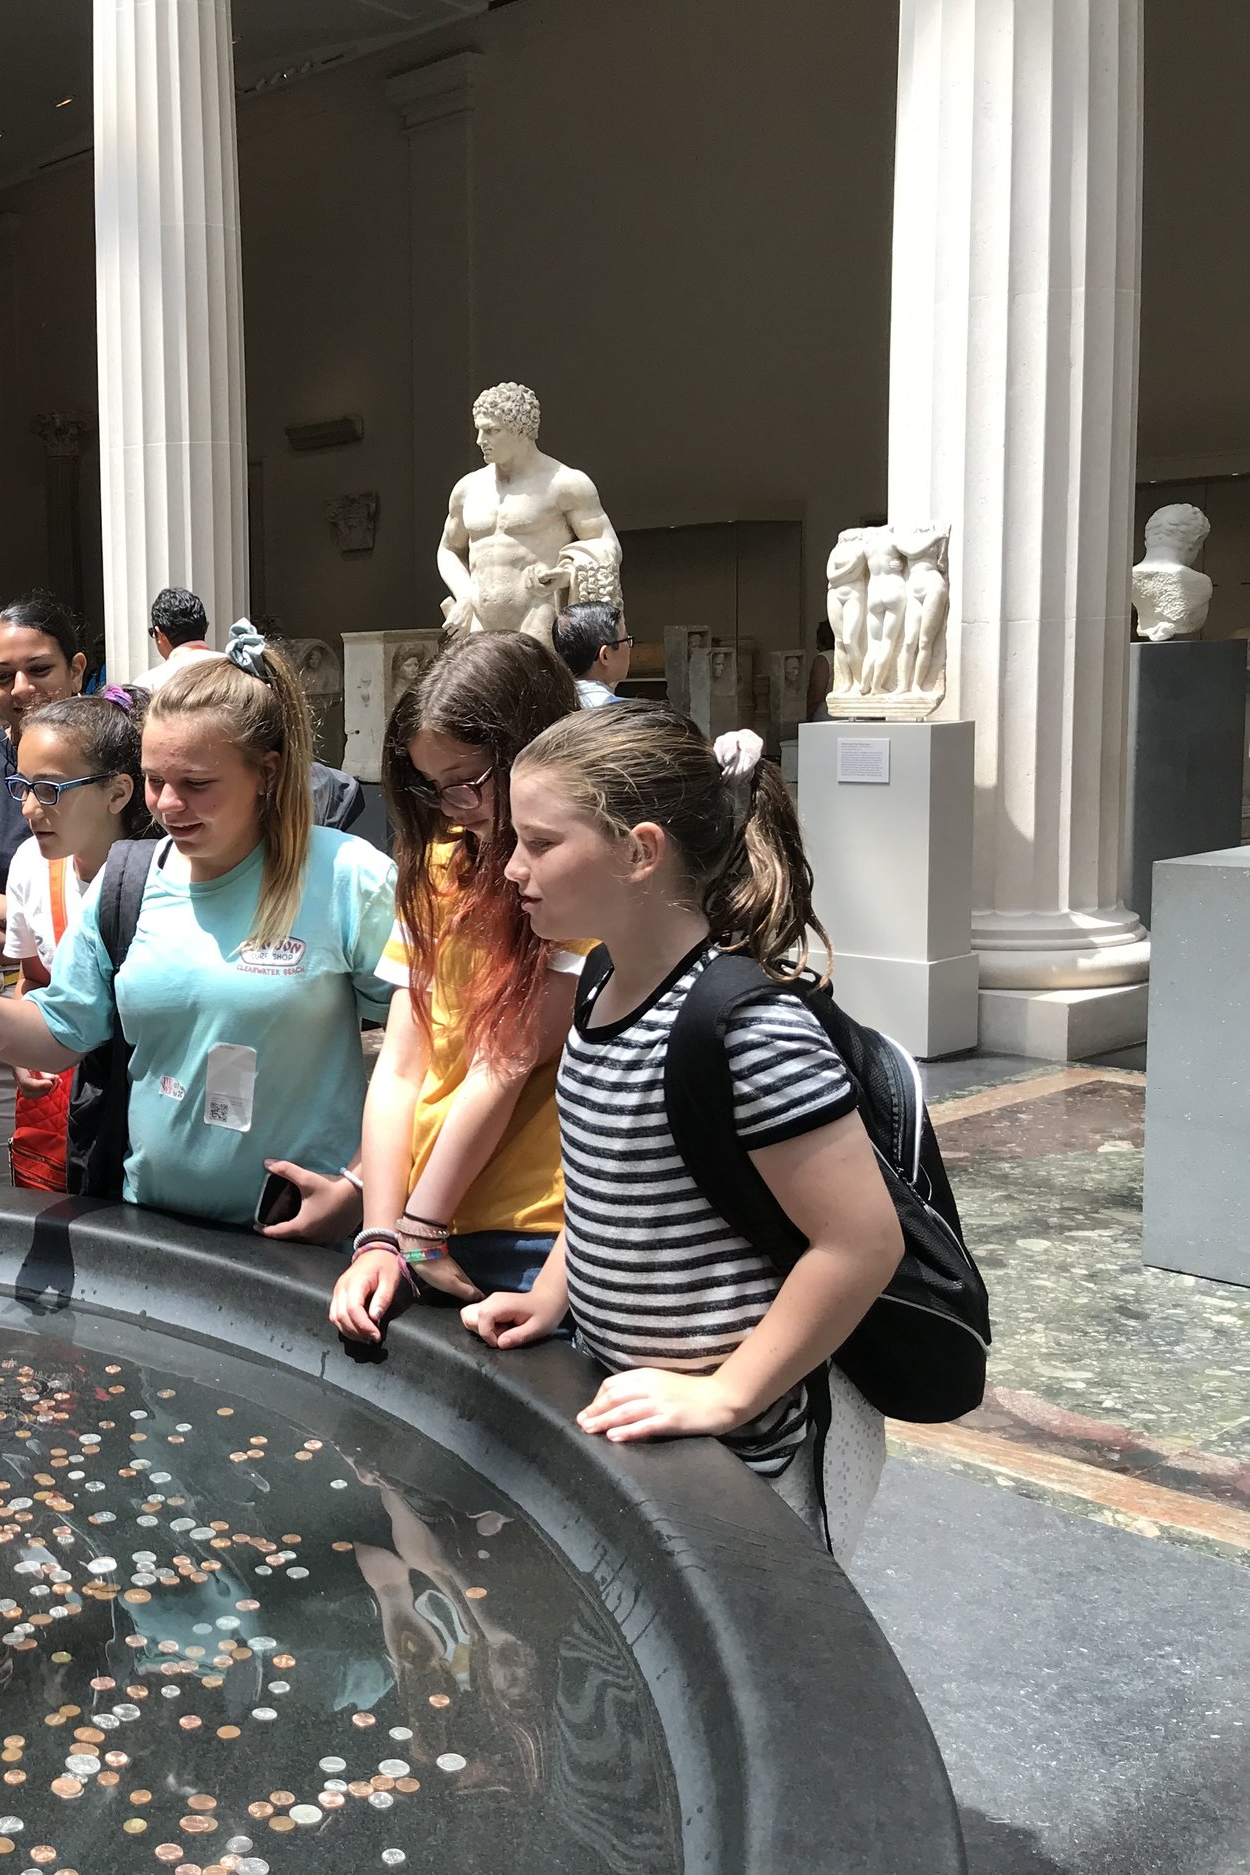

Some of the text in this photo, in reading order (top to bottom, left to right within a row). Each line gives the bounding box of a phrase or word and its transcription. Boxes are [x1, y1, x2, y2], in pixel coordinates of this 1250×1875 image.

[273, 952, 293, 961] SHOP
[236, 964, 306, 976] CLEARWATER BEACH
